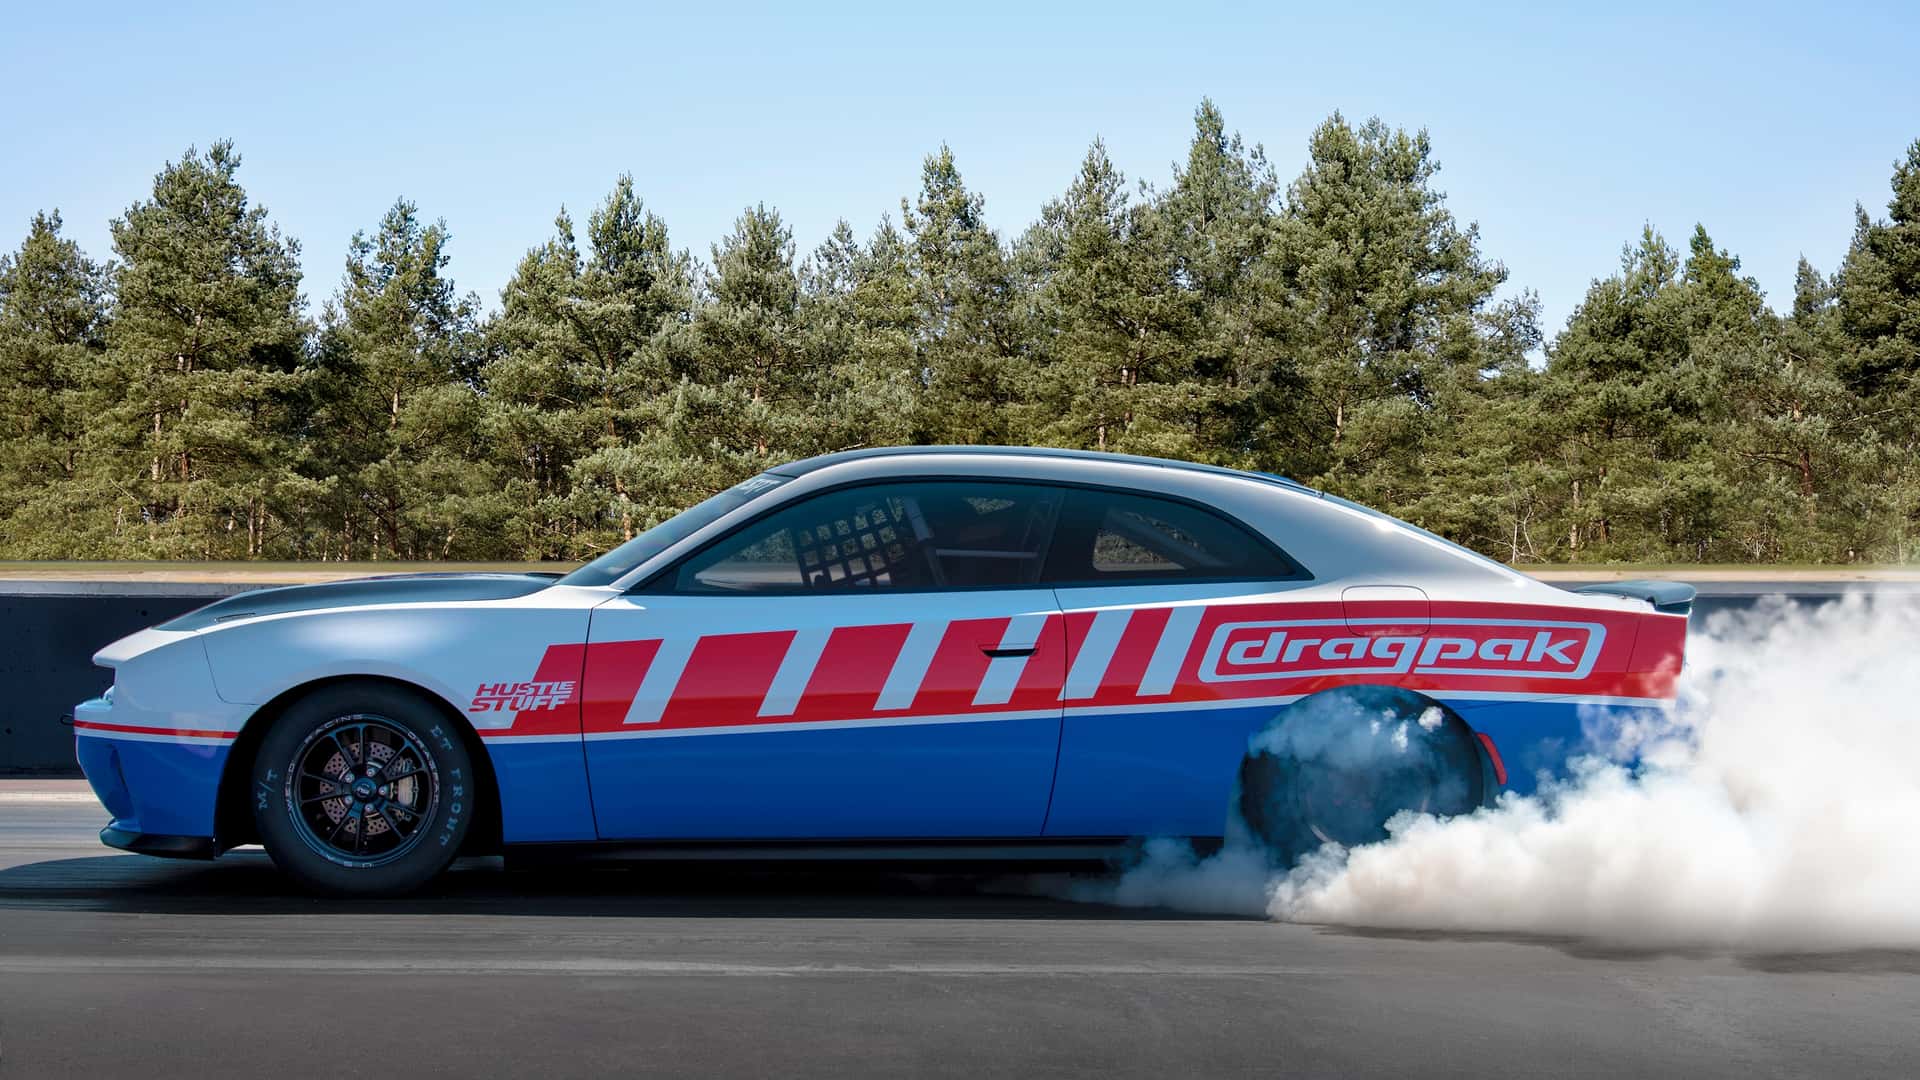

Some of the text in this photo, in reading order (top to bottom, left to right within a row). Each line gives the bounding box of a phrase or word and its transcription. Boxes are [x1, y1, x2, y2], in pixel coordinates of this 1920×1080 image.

[1226, 631, 1580, 672] dragpak
[468, 694, 572, 712] STUFF
[476, 680, 577, 697] HUSTLE
[256, 768, 279, 809] M/T
[431, 724, 464, 846] ET FRONT
